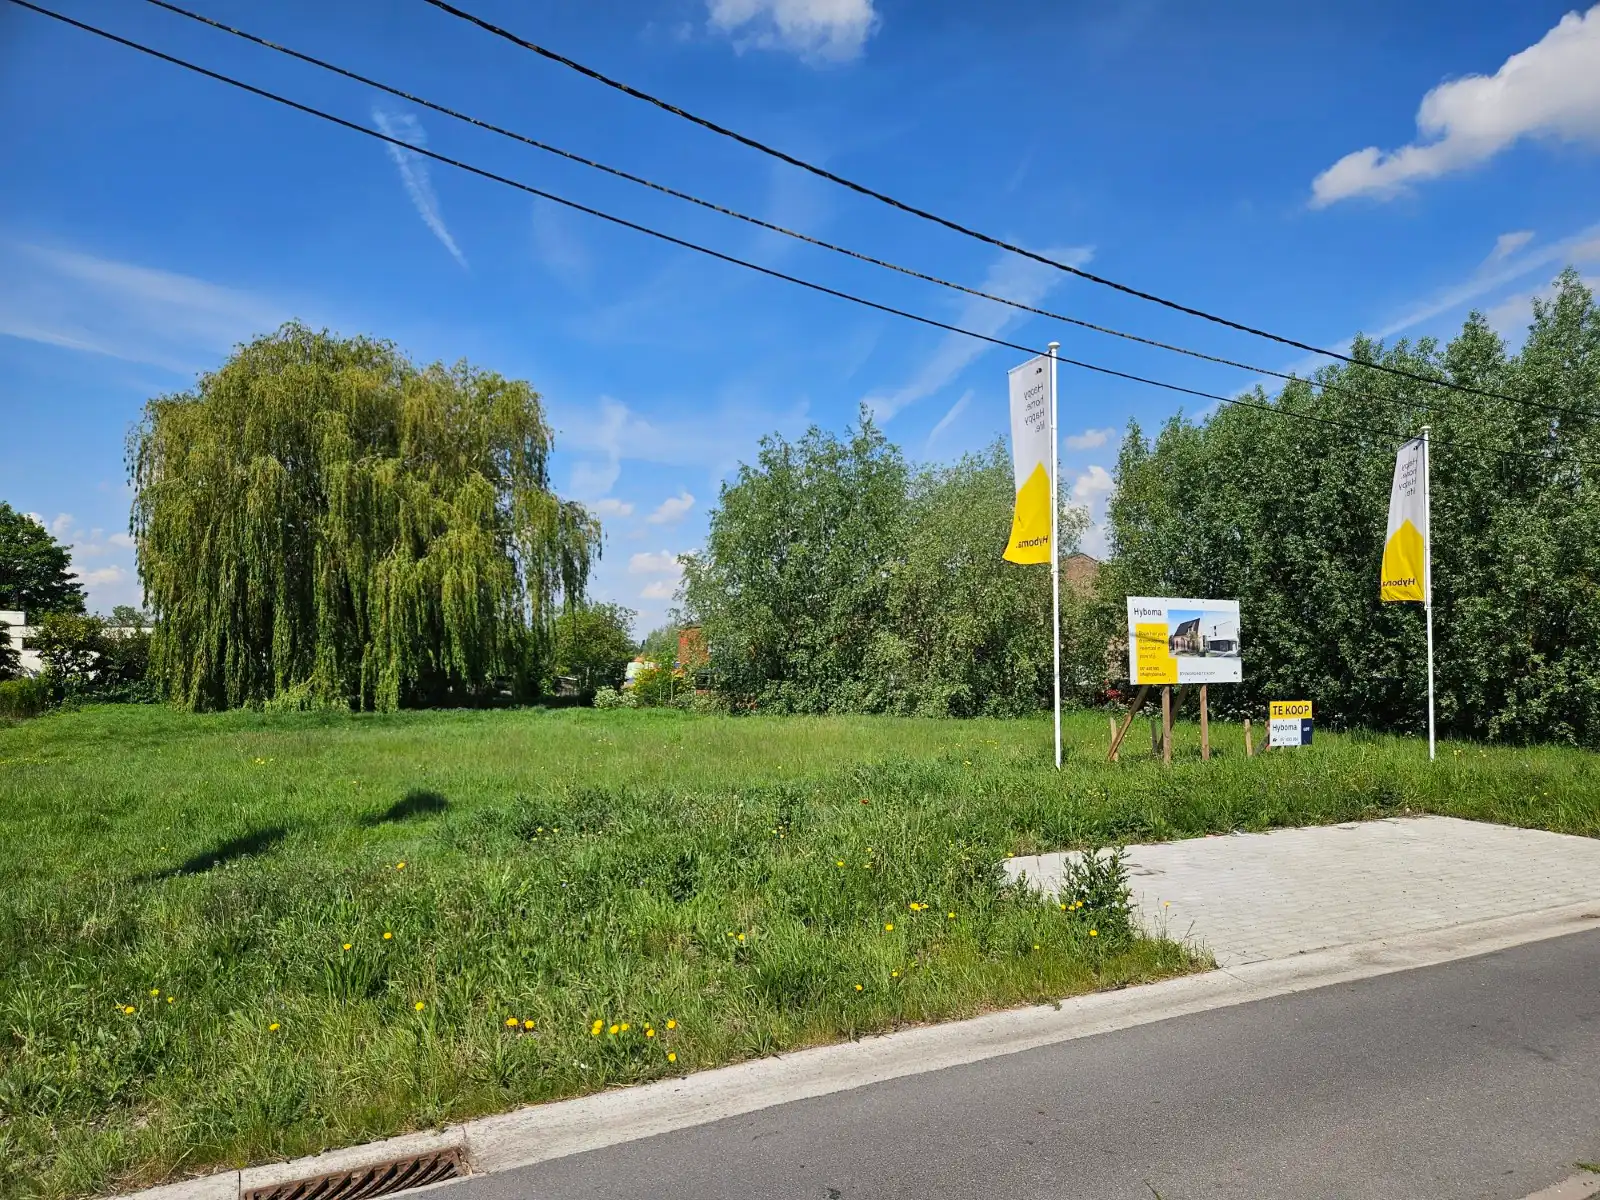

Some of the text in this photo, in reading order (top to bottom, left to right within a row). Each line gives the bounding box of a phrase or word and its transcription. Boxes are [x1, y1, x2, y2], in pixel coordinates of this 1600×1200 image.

[1134, 607, 1162, 618] Hyboma
[1272, 705, 1309, 715] TE KOOP
[1272, 724, 1298, 732] Hyboma
